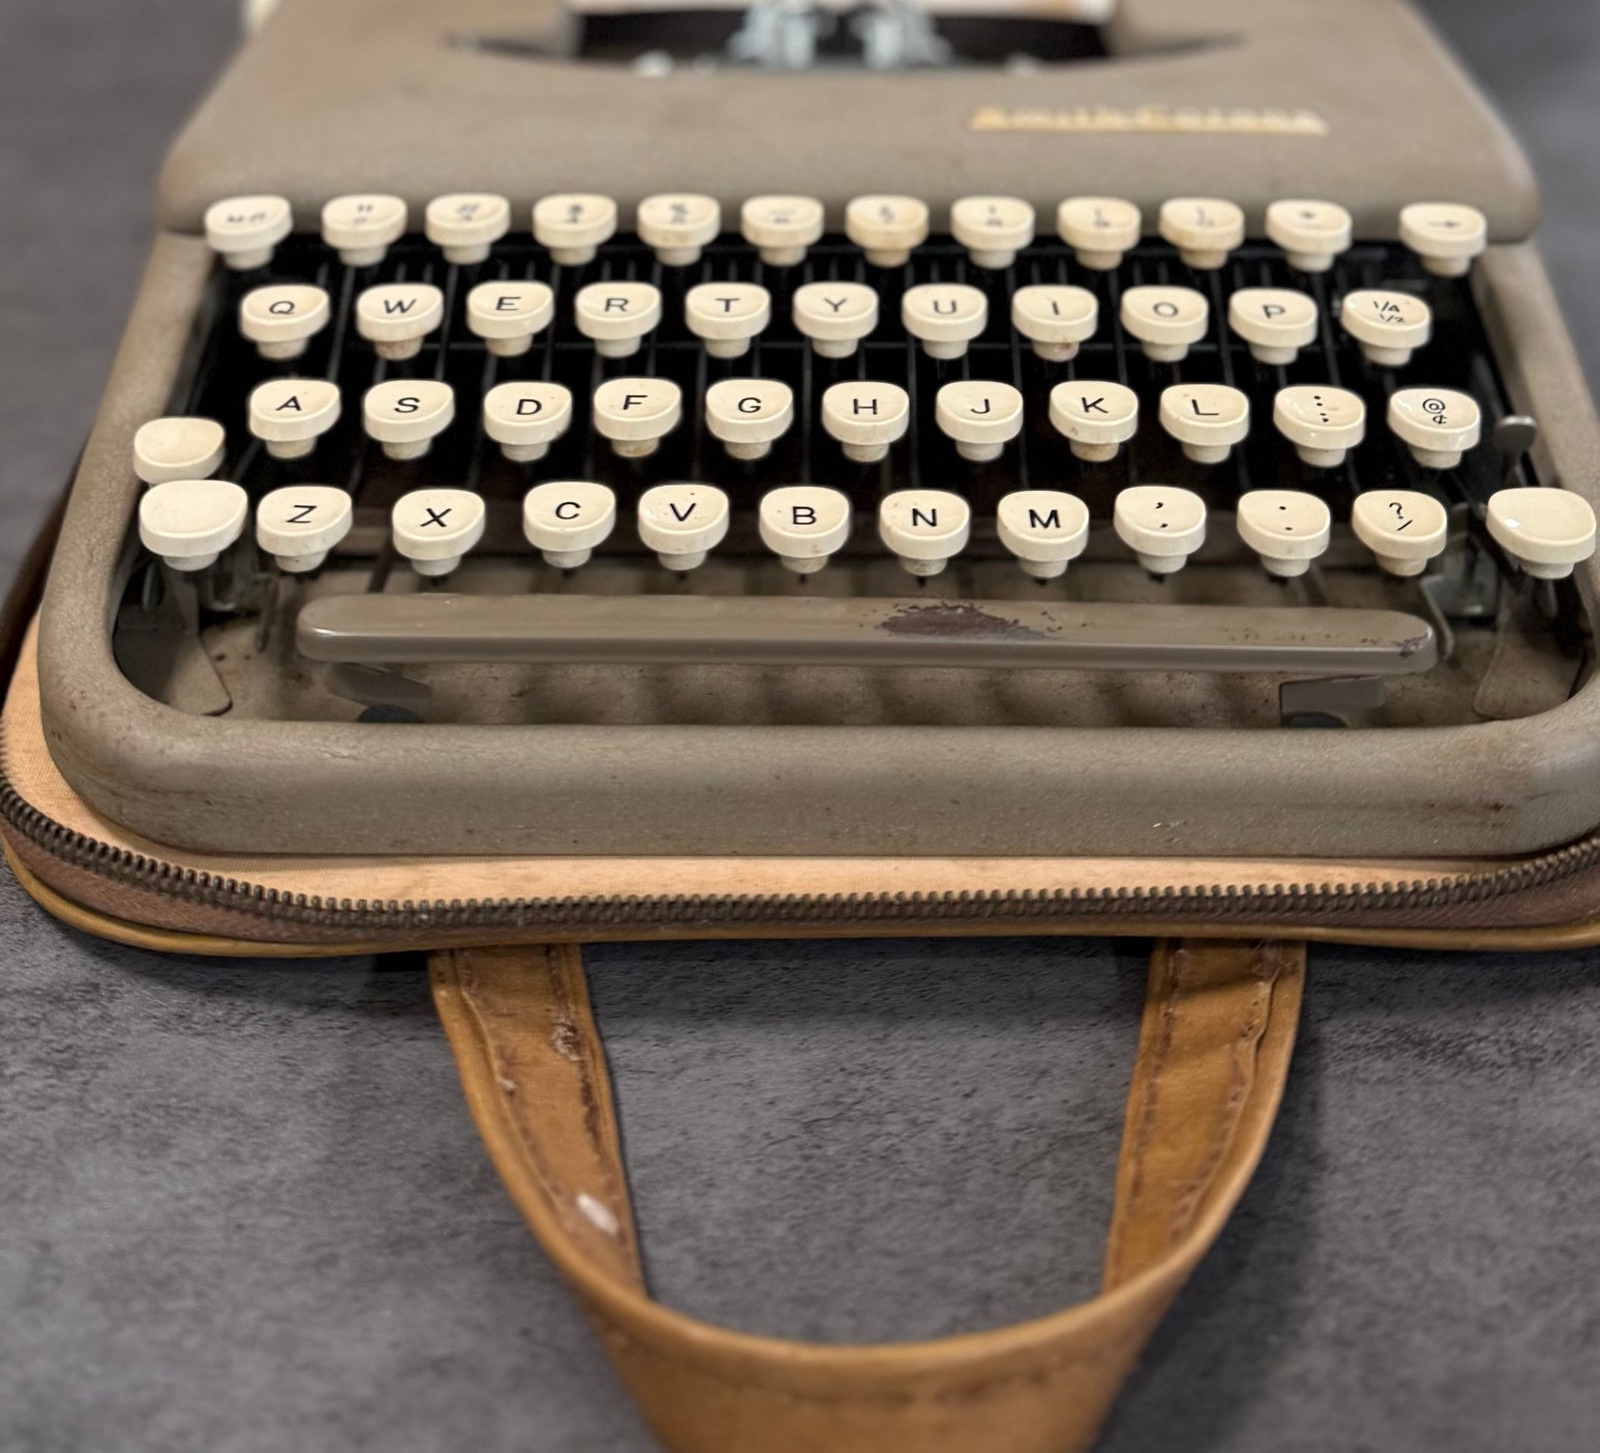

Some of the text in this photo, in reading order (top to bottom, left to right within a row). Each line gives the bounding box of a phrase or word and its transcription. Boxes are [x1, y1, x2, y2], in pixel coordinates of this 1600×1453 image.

[269, 301, 295, 315] Q
[384, 299, 416, 314] W
[495, 296, 521, 311] E
[604, 298, 629, 312] R
[715, 298, 740, 312] T
[824, 298, 847, 312] Y
[933, 300, 957, 314] U
[1052, 301, 1060, 315] I
[1153, 302, 1179, 317] O
[1263, 305, 1285, 319] P
[275, 396, 302, 411] A
[394, 397, 420, 413] S
[516, 399, 542, 415] D
[622, 395, 648, 410] F
[738, 397, 762, 413] G
[853, 398, 878, 415] H
[970, 398, 991, 414] J
[1081, 397, 1109, 414] K
[1191, 399, 1219, 416] L
[1422, 398, 1446, 414] @
[285, 505, 317, 524] Z
[420, 508, 452, 528] X
[555, 502, 581, 520] C
[669, 503, 696, 522] V
[792, 506, 817, 525] B
[912, 508, 938, 527] N
[1389, 502, 1404, 519] ?
[1028, 509, 1061, 529] M
